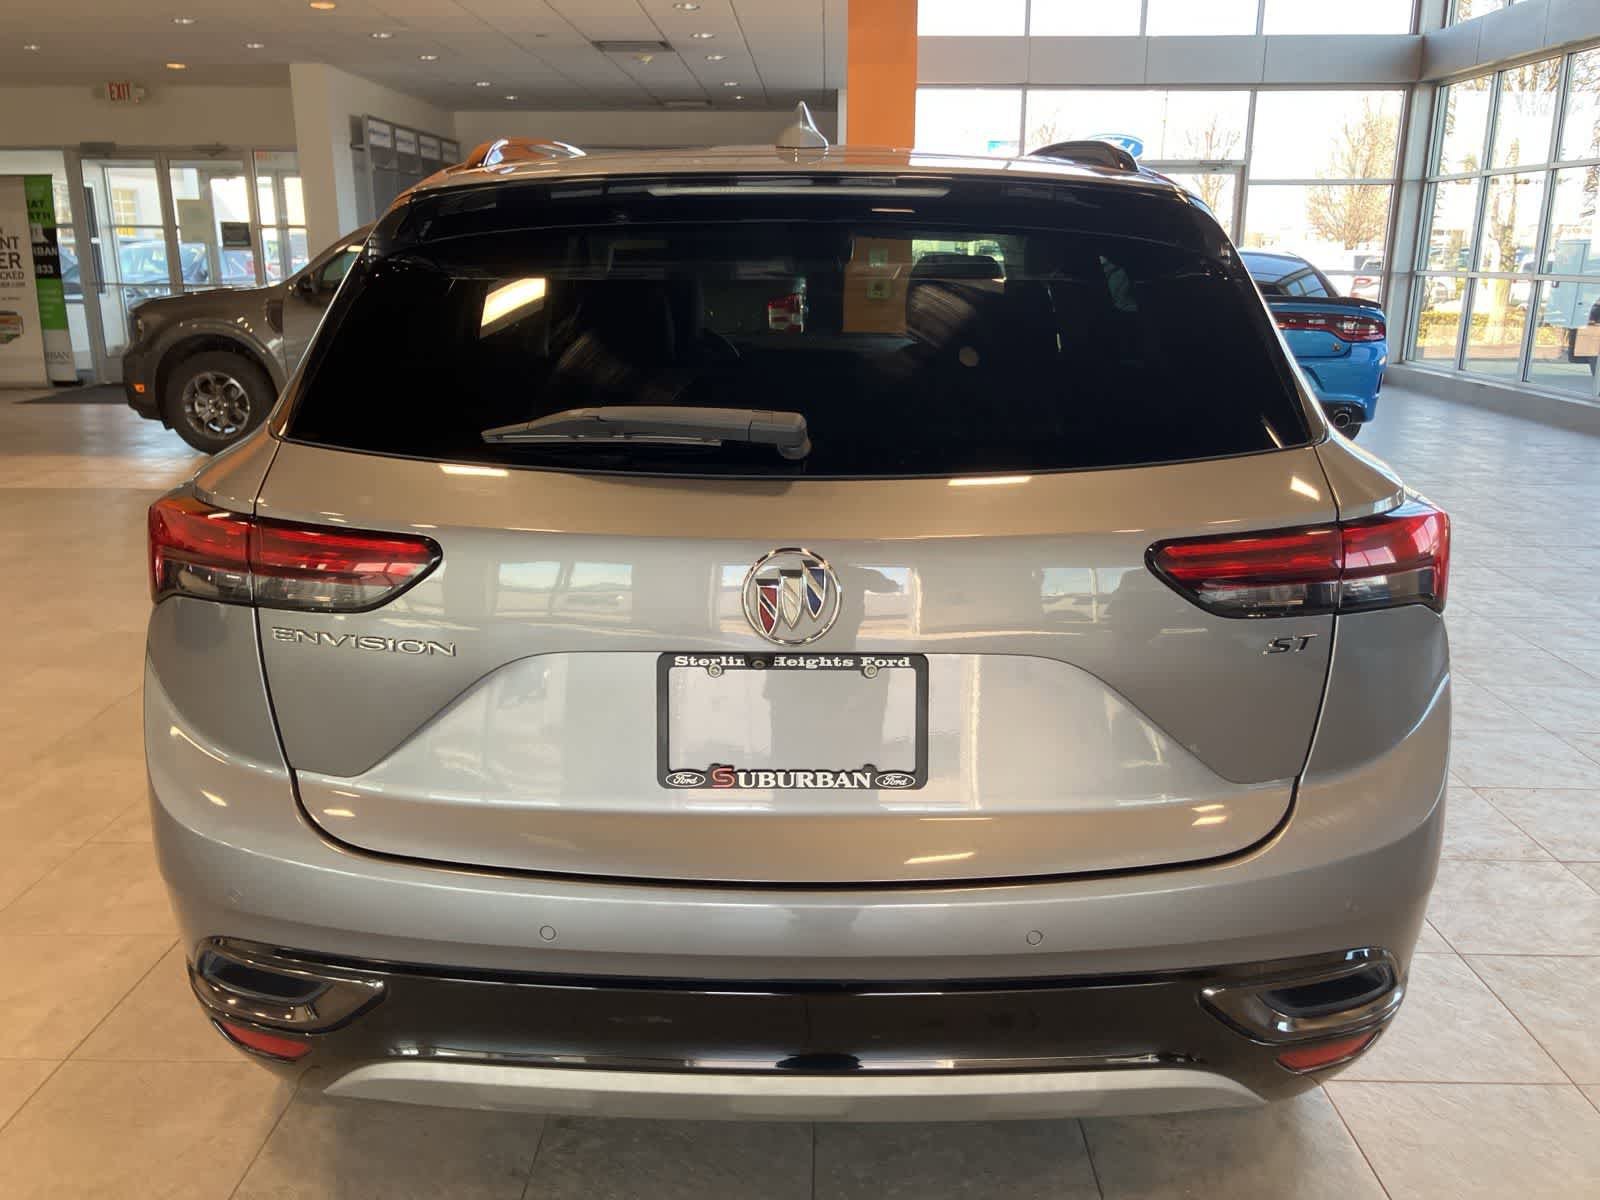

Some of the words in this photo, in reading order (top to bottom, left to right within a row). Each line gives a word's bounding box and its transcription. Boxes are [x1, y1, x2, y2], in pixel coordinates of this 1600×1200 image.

[107, 82, 131, 101] EXIT
[272, 626, 456, 657] ENVISION
[1261, 633, 1319, 656] ST
[674, 656, 746, 666] Sterlin
[773, 656, 854, 669] Heights
[860, 656, 912, 667] Ford
[712, 767, 871, 788] SUBURBAN
